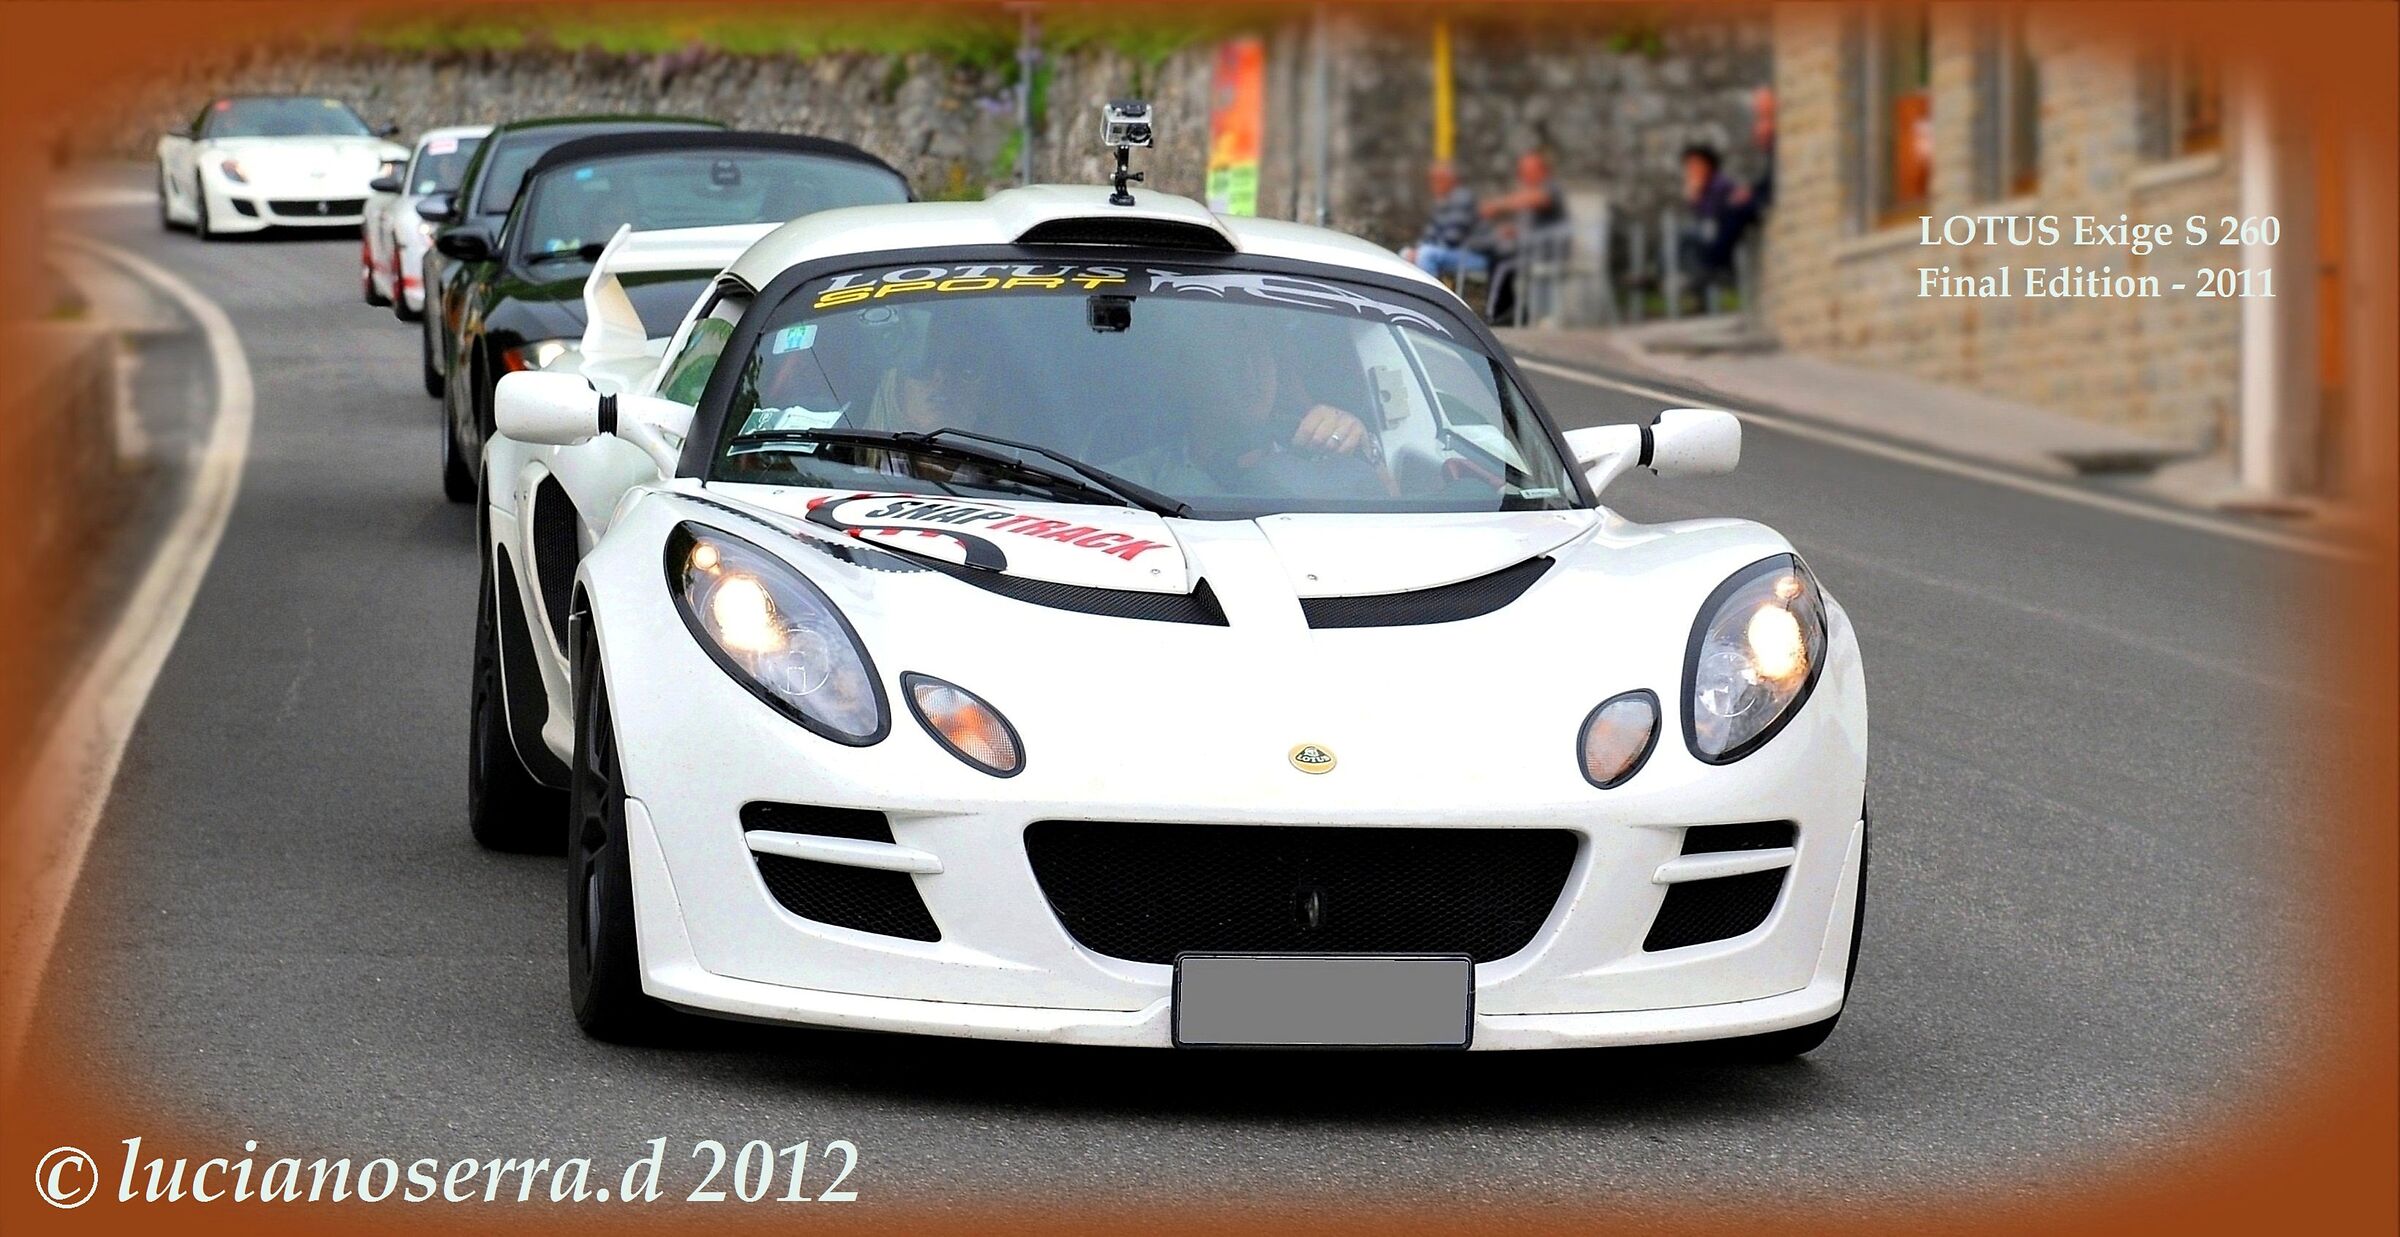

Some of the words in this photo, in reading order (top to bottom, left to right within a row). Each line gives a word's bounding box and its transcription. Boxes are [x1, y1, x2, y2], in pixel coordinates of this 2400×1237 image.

[813, 276, 1128, 309] SPORT
[817, 265, 1129, 296] LOTUS
[865, 501, 1171, 561] SNAPTRACK
